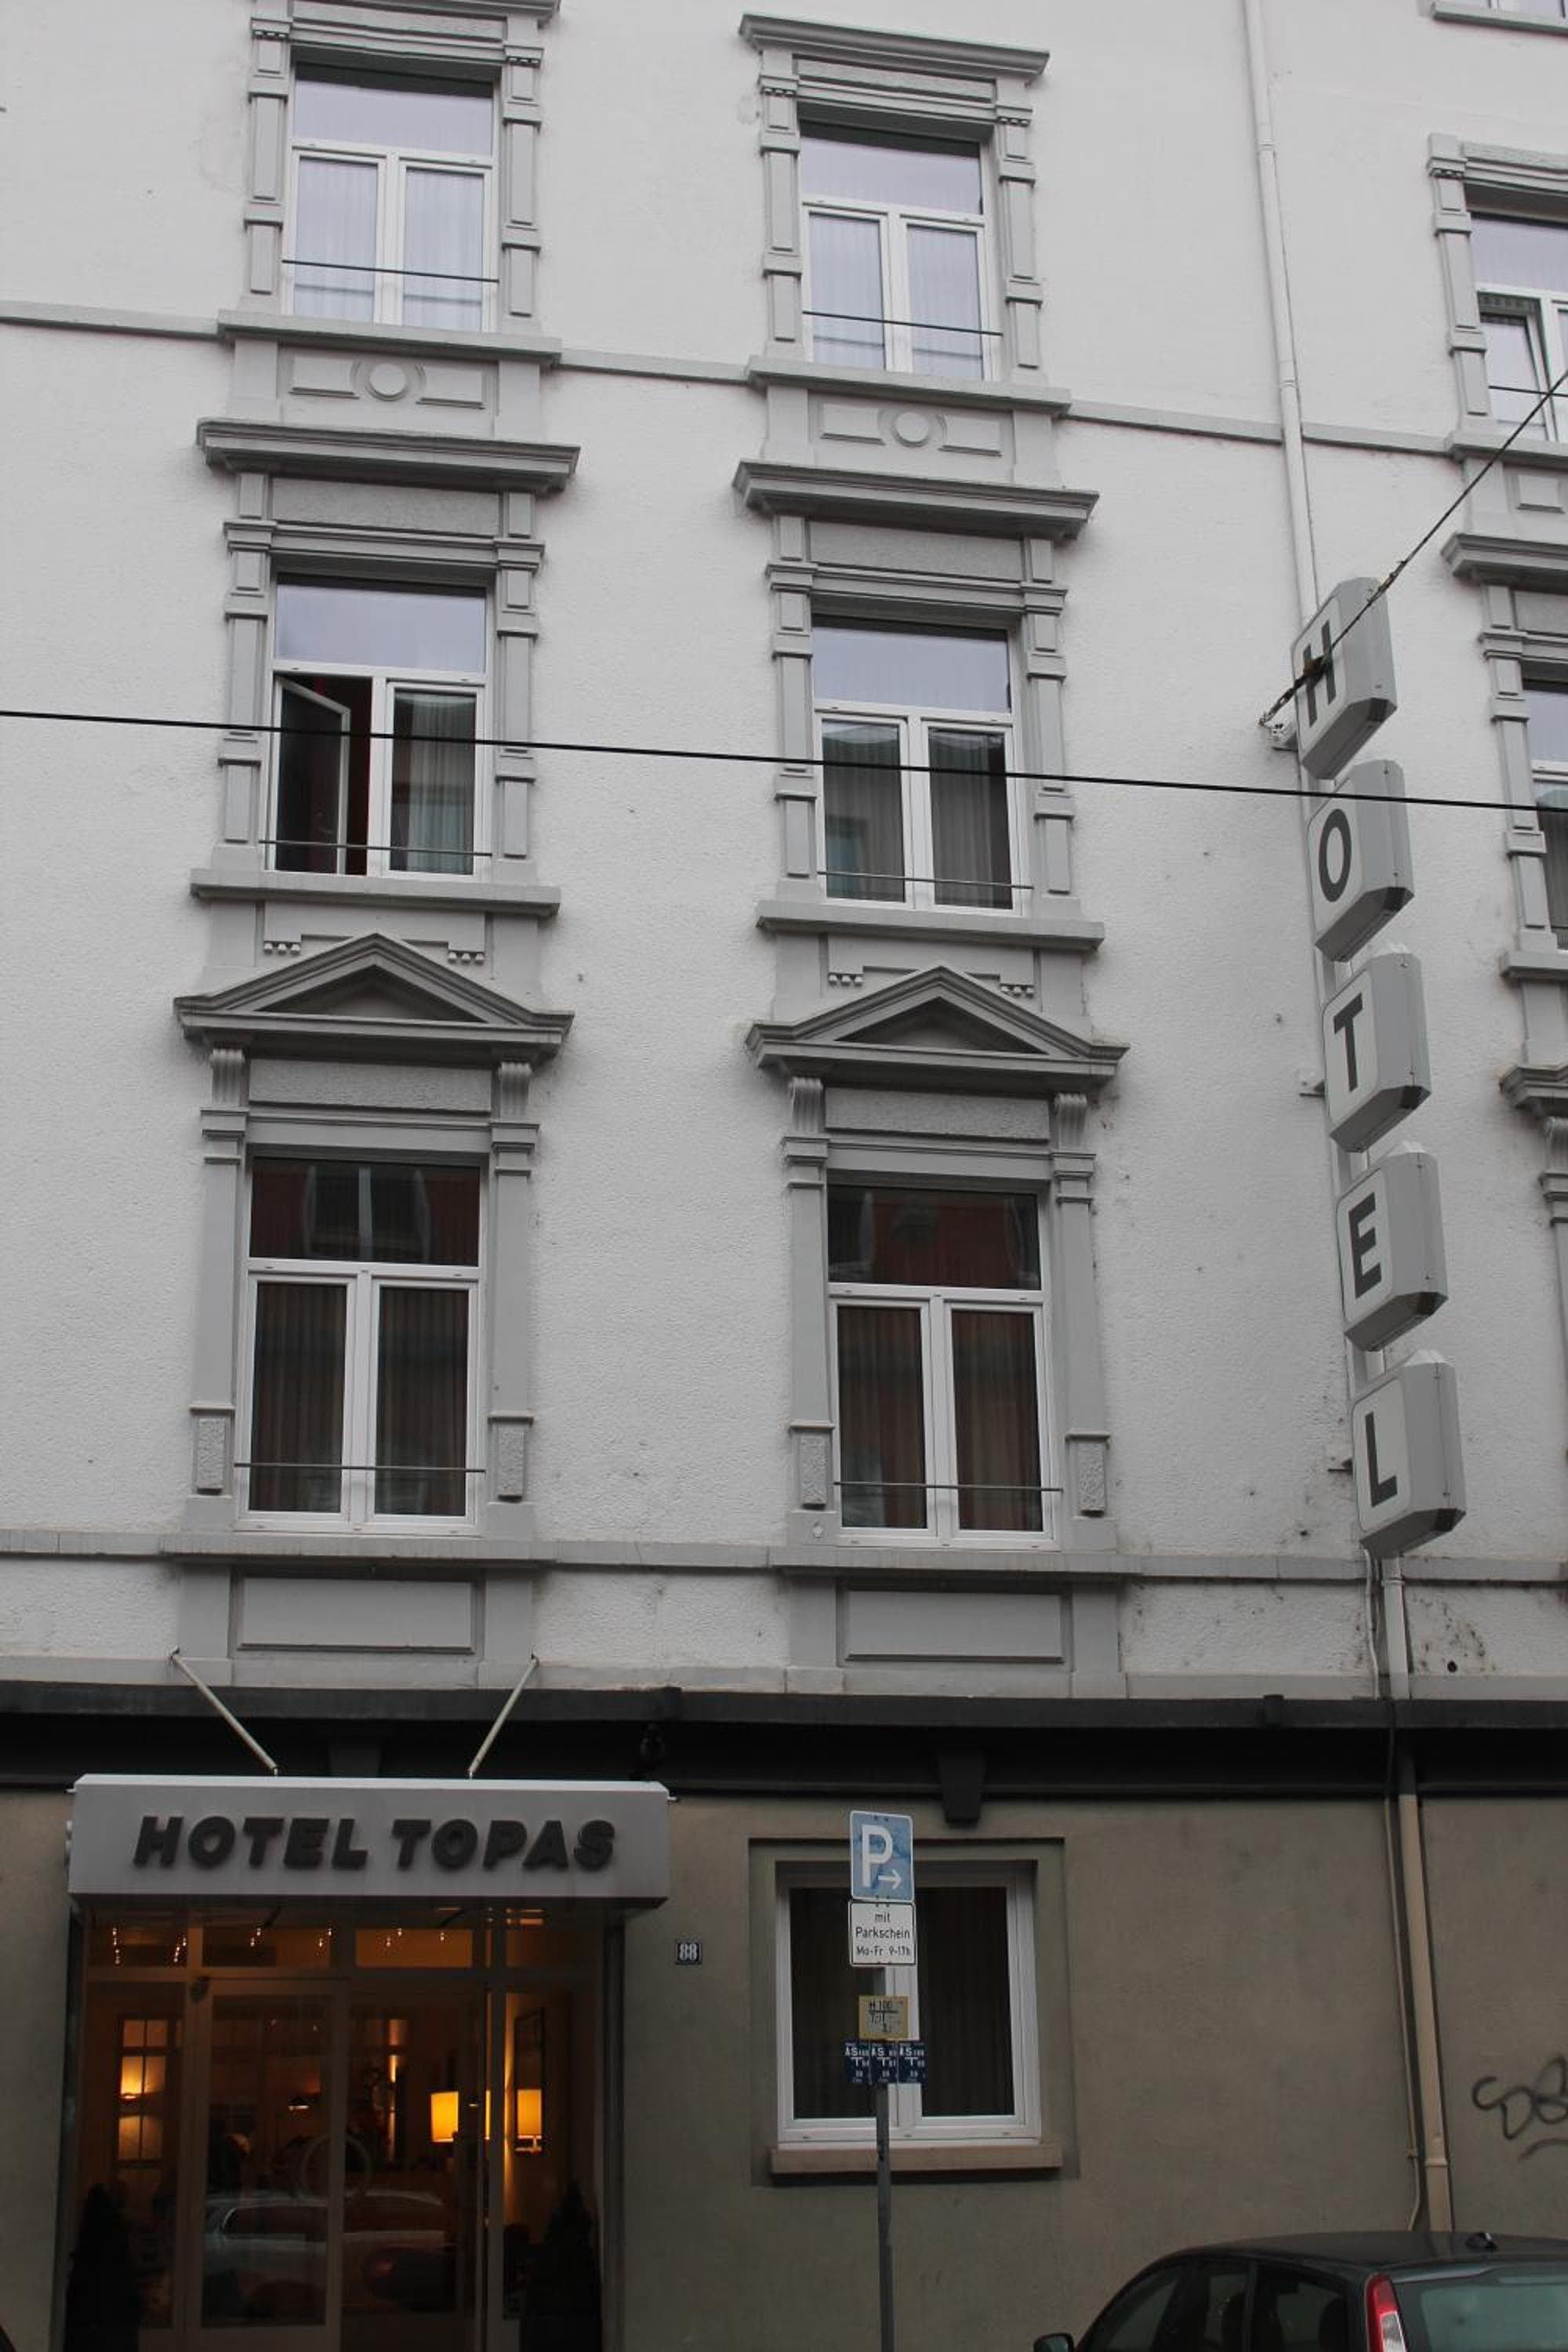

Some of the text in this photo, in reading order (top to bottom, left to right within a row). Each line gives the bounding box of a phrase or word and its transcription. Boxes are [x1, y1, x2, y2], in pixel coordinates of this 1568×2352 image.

[1301, 618, 1399, 1508] HOTEL
[132, 1815, 616, 1872] HOTEL TOPAS
[861, 1824, 894, 1888] P
[855, 1926, 910, 1939] Parkschein
[874, 1911, 891, 1923] mit
[679, 1943, 698, 1961] 88
